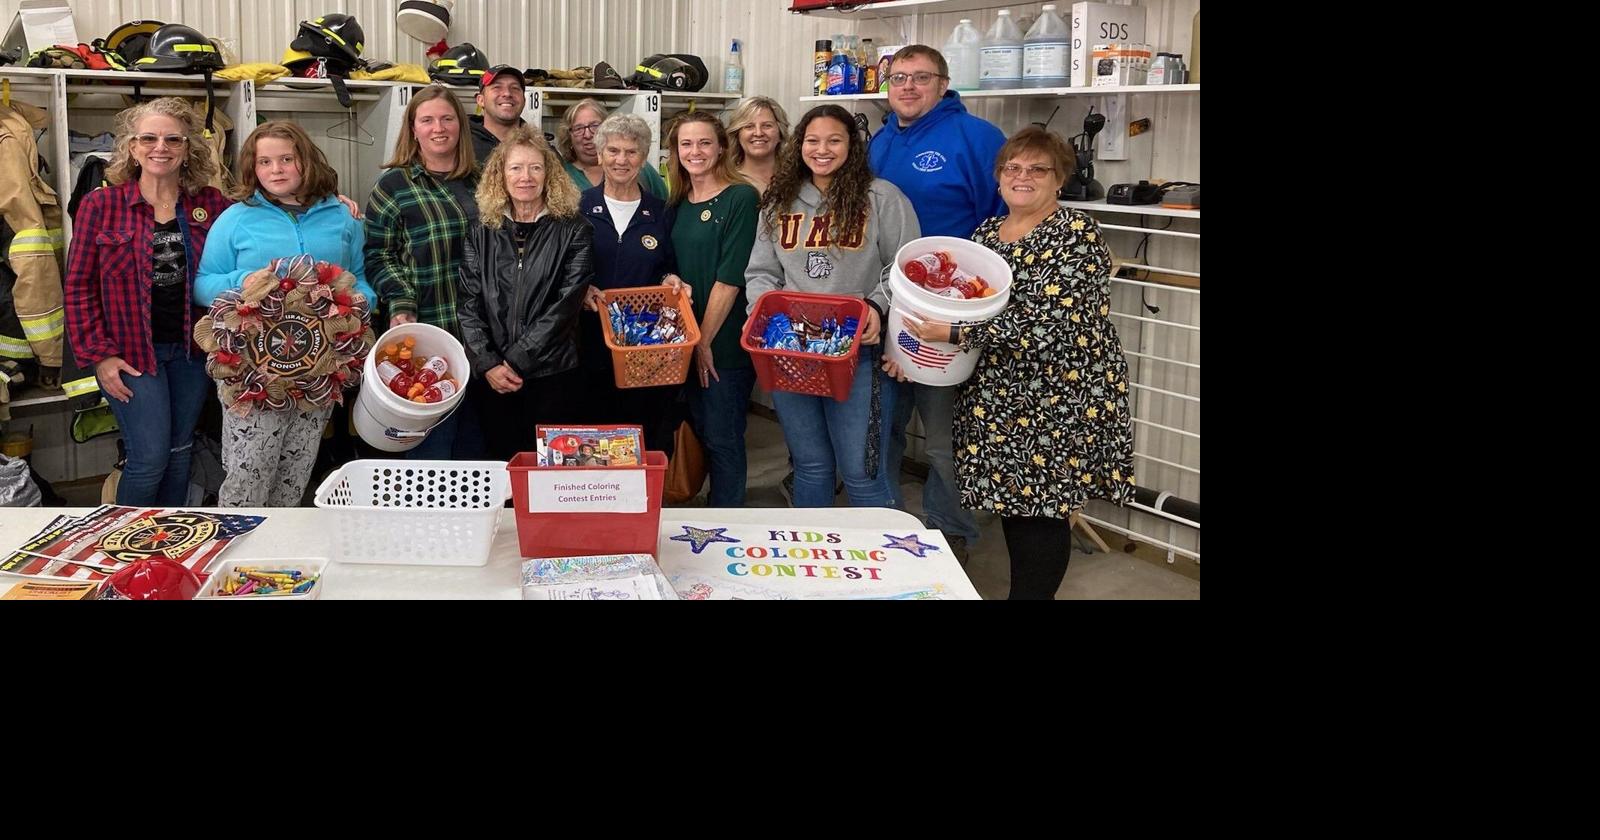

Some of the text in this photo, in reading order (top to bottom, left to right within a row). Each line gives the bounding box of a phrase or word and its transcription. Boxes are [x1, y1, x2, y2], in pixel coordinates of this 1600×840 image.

[1100, 21, 1129, 40] SDS
[243, 80, 252, 103] 16
[399, 86, 408, 106] 17
[529, 91, 540, 110] 18
[646, 95, 658, 112] 19
[285, 313, 310, 324] URAGE
[312, 329, 321, 356] SERVICE
[270, 361, 302, 369] HONOR
[554, 482, 620, 491] Finished Coloring
[558, 494, 617, 503] Contest Entries
[106, 523, 146, 546] SERVE
[768, 530, 842, 544] KIDS
[725, 546, 887, 562] COLORING
[726, 562, 883, 580] CONTEST
